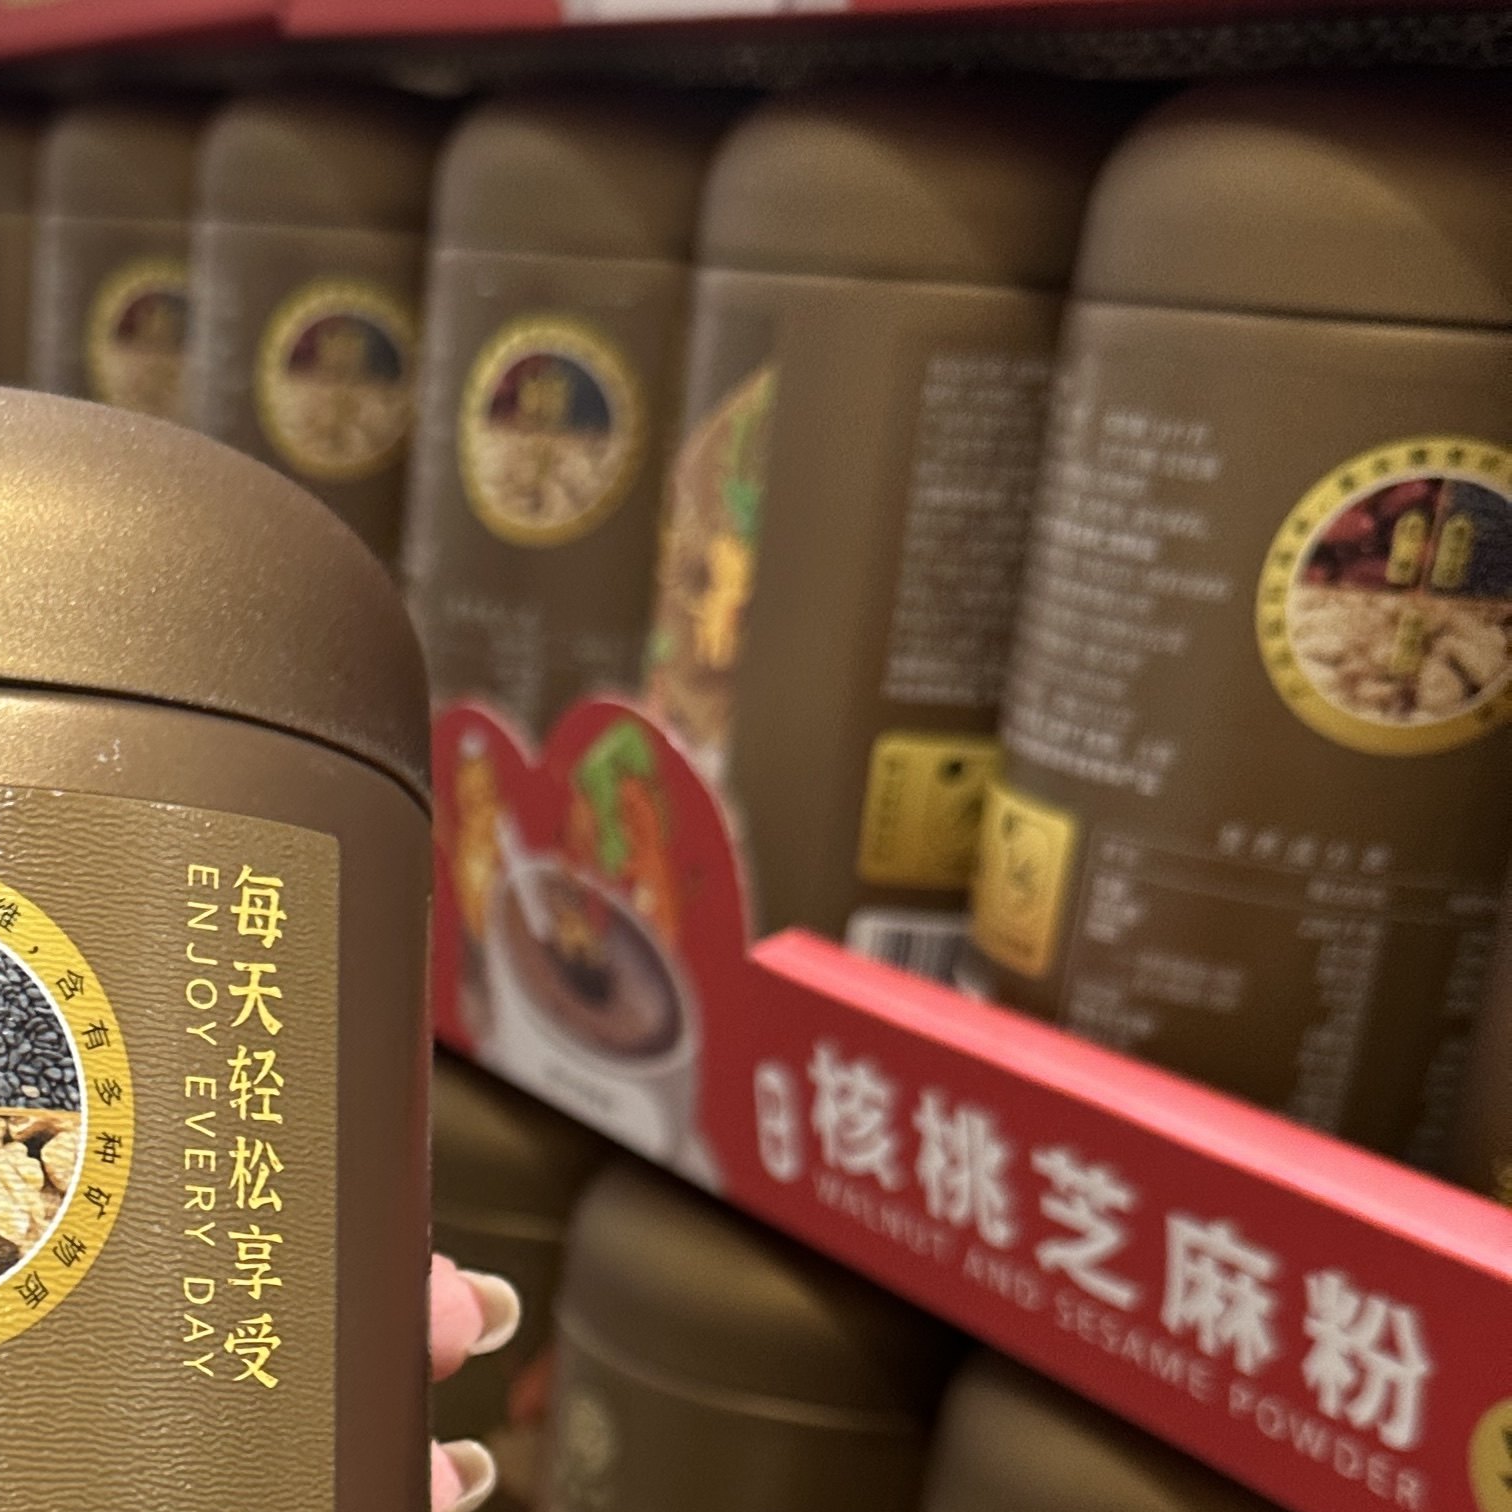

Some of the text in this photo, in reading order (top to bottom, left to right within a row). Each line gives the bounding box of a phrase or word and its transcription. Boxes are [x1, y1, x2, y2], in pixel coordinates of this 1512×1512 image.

[182, 864, 220, 1378] ENJOY EVERY DAY
[224, 863, 288, 1389] 每天轻松享受
[806, 1038, 1435, 1452] 核桃芝麻粉
[1053, 1293, 1217, 1402] SESAME
